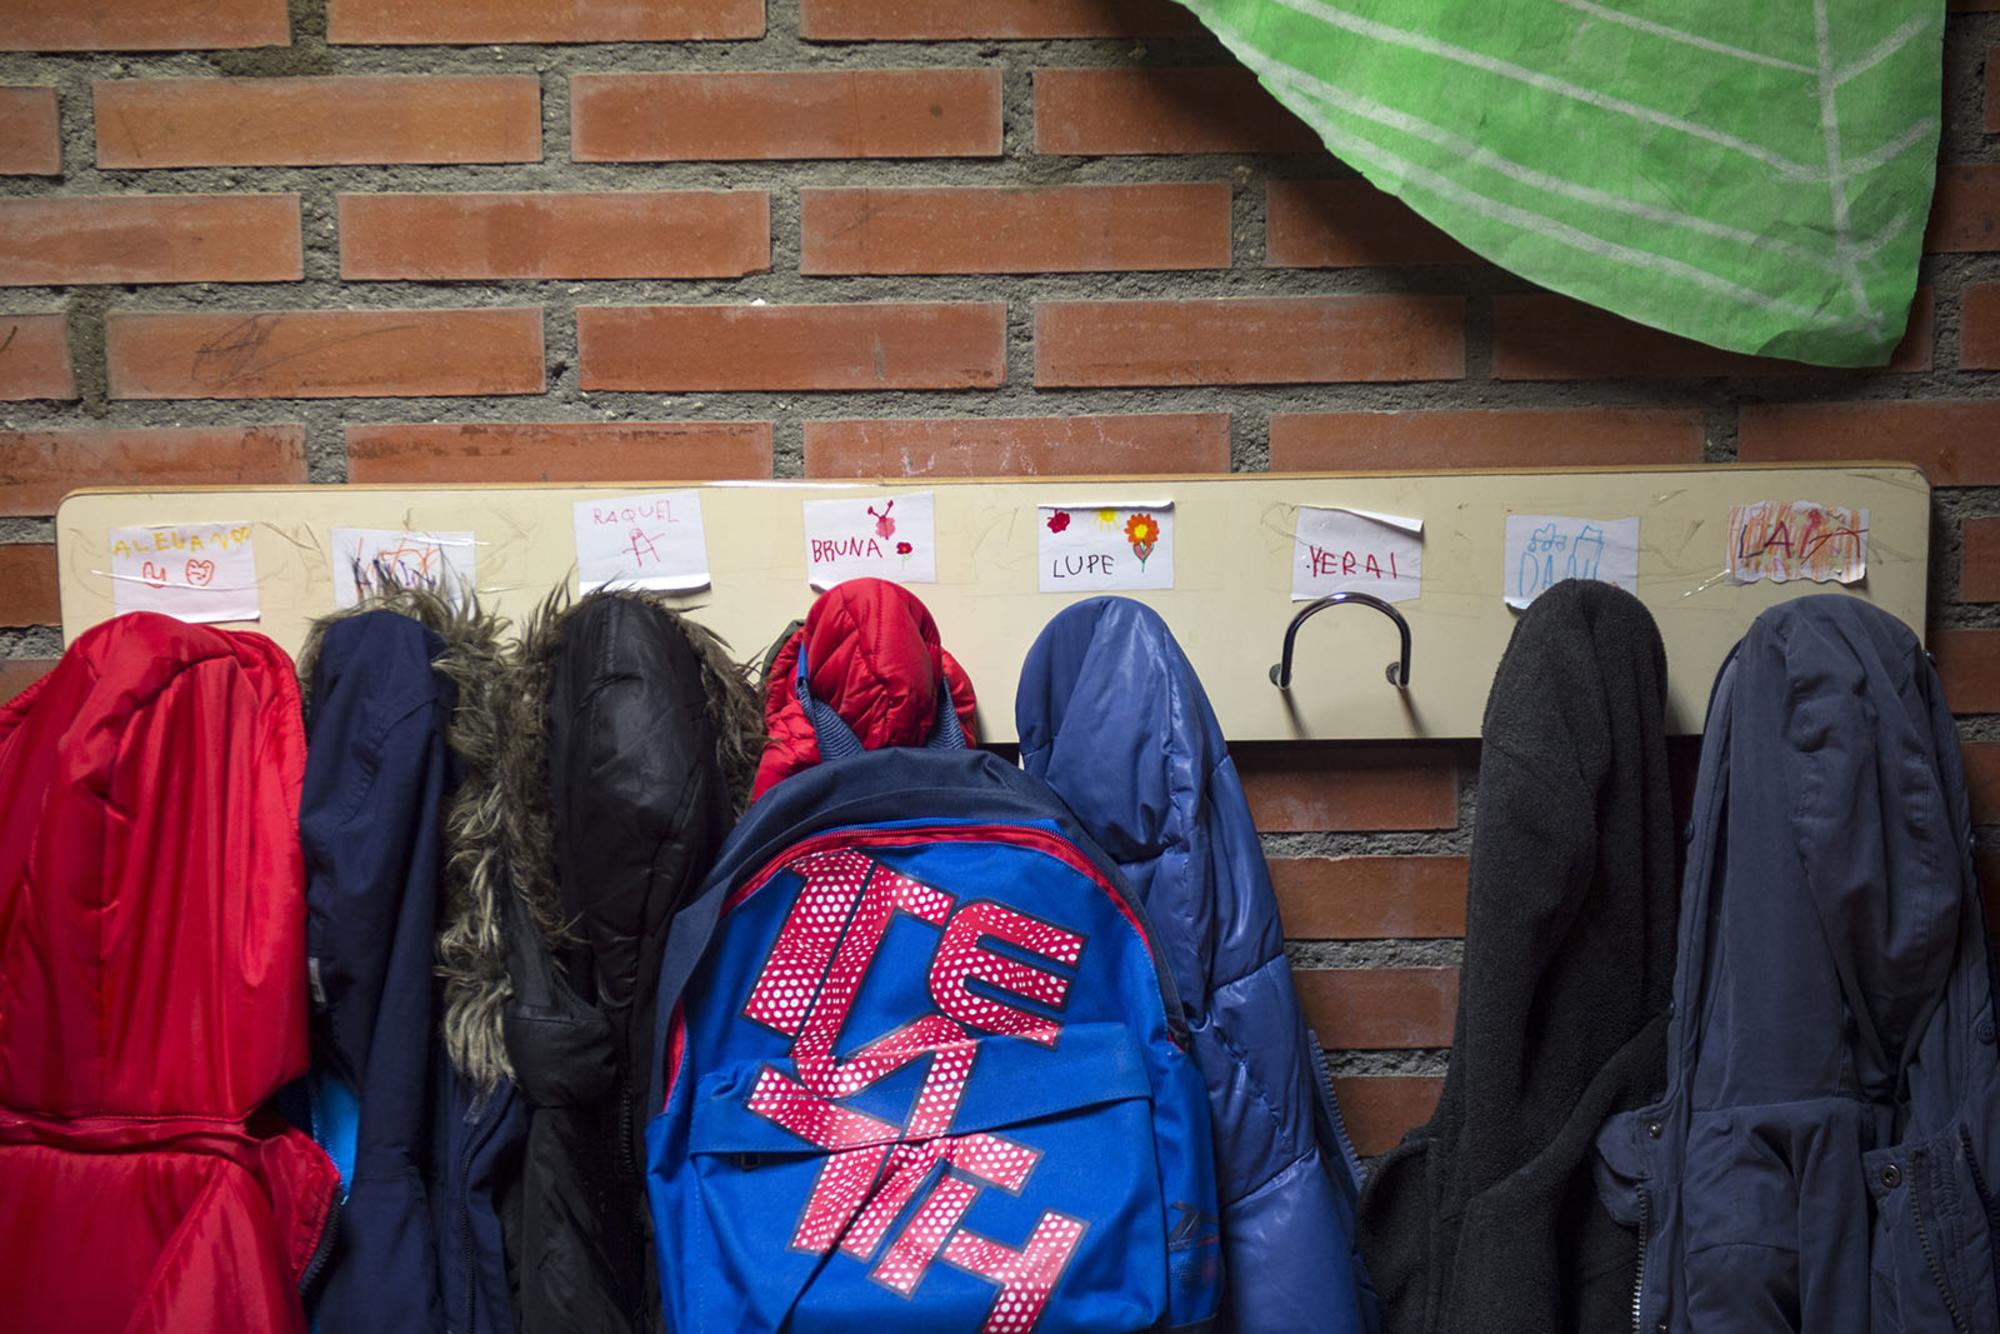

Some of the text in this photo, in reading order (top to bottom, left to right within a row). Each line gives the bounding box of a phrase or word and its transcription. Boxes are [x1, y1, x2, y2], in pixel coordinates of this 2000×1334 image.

[592, 499, 679, 525] RAQUEL
[810, 536, 883, 563] BRUNA
[1308, 544, 1398, 579] YERAI
[1053, 554, 1115, 578] LUPE
